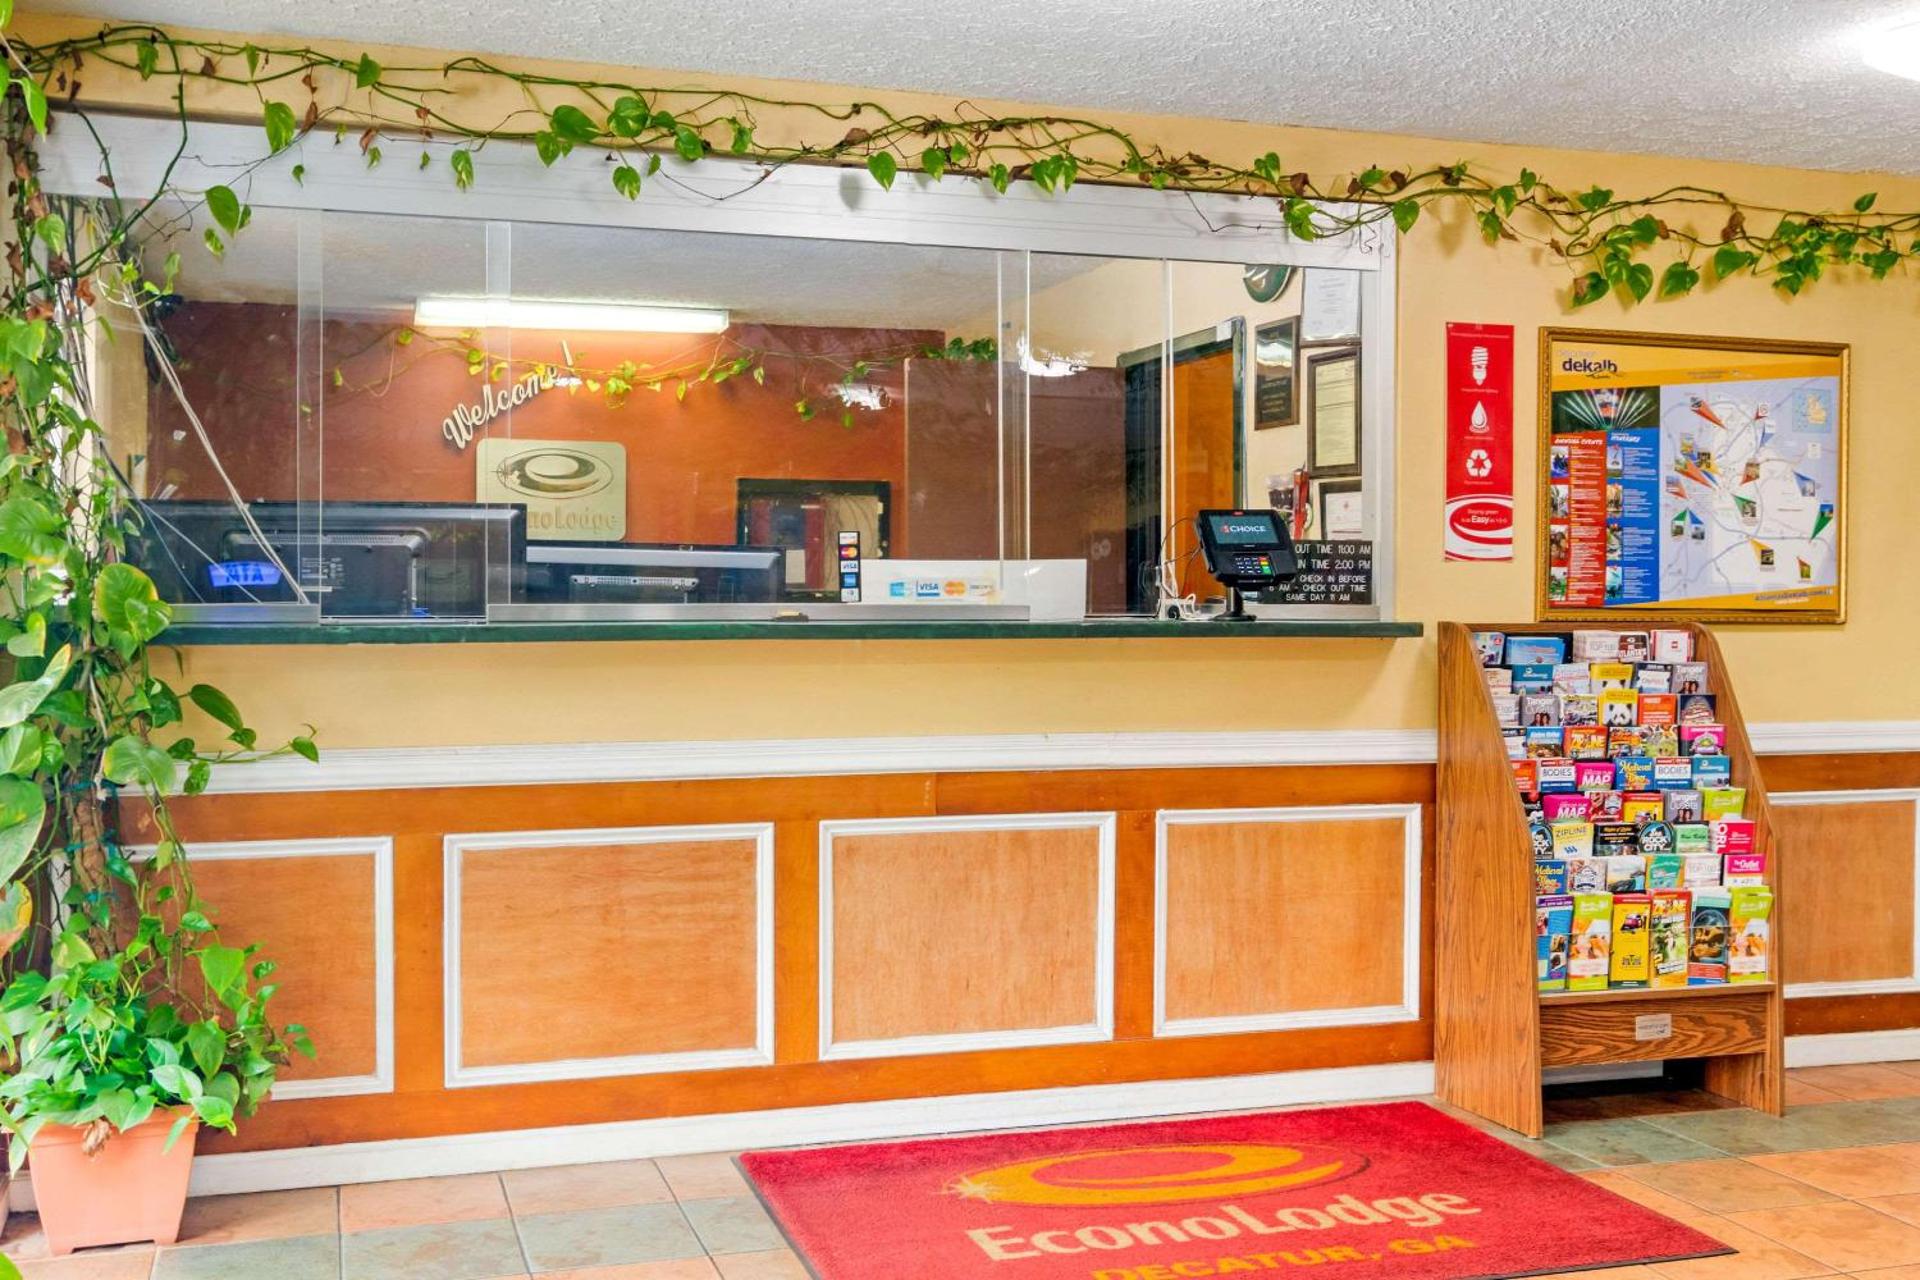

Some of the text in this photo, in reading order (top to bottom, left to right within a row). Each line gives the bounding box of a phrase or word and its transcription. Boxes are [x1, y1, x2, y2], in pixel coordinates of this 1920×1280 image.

[1562, 358, 1618, 373] dekalb
[527, 505, 614, 535] noLodge
[1295, 543, 1311, 554] OUT
[1316, 543, 1333, 554] TIME
[1359, 545, 1371, 554] AM
[1297, 559, 1371, 570] IN TIME 2:00 PM
[1300, 575, 1367, 583] CHECK IN BEFORE
[919, 583, 939, 591] VISA
[1279, 584, 1290, 592] AM
[1302, 584, 1326, 592] CHECK
[1330, 584, 1345, 592] OUT
[1350, 584, 1367, 592] TIME
[1286, 593, 1306, 601] SAME
[1310, 593, 1326, 601] DAY
[1339, 593, 1350, 601] AM
[1542, 768, 1572, 777] BODIES
[1658, 766, 1689, 775] BODIES
[1582, 774, 1611, 786] MAP
[1556, 806, 1587, 818] MAP
[1556, 826, 1587, 838] ZIPLINE
[1641, 836, 1668, 845] ROCK
[1643, 844, 1664, 852] CITY
[965, 1193, 1482, 1261] EconoLodge
[1091, 1234, 1479, 1280] DECATUR, GA
